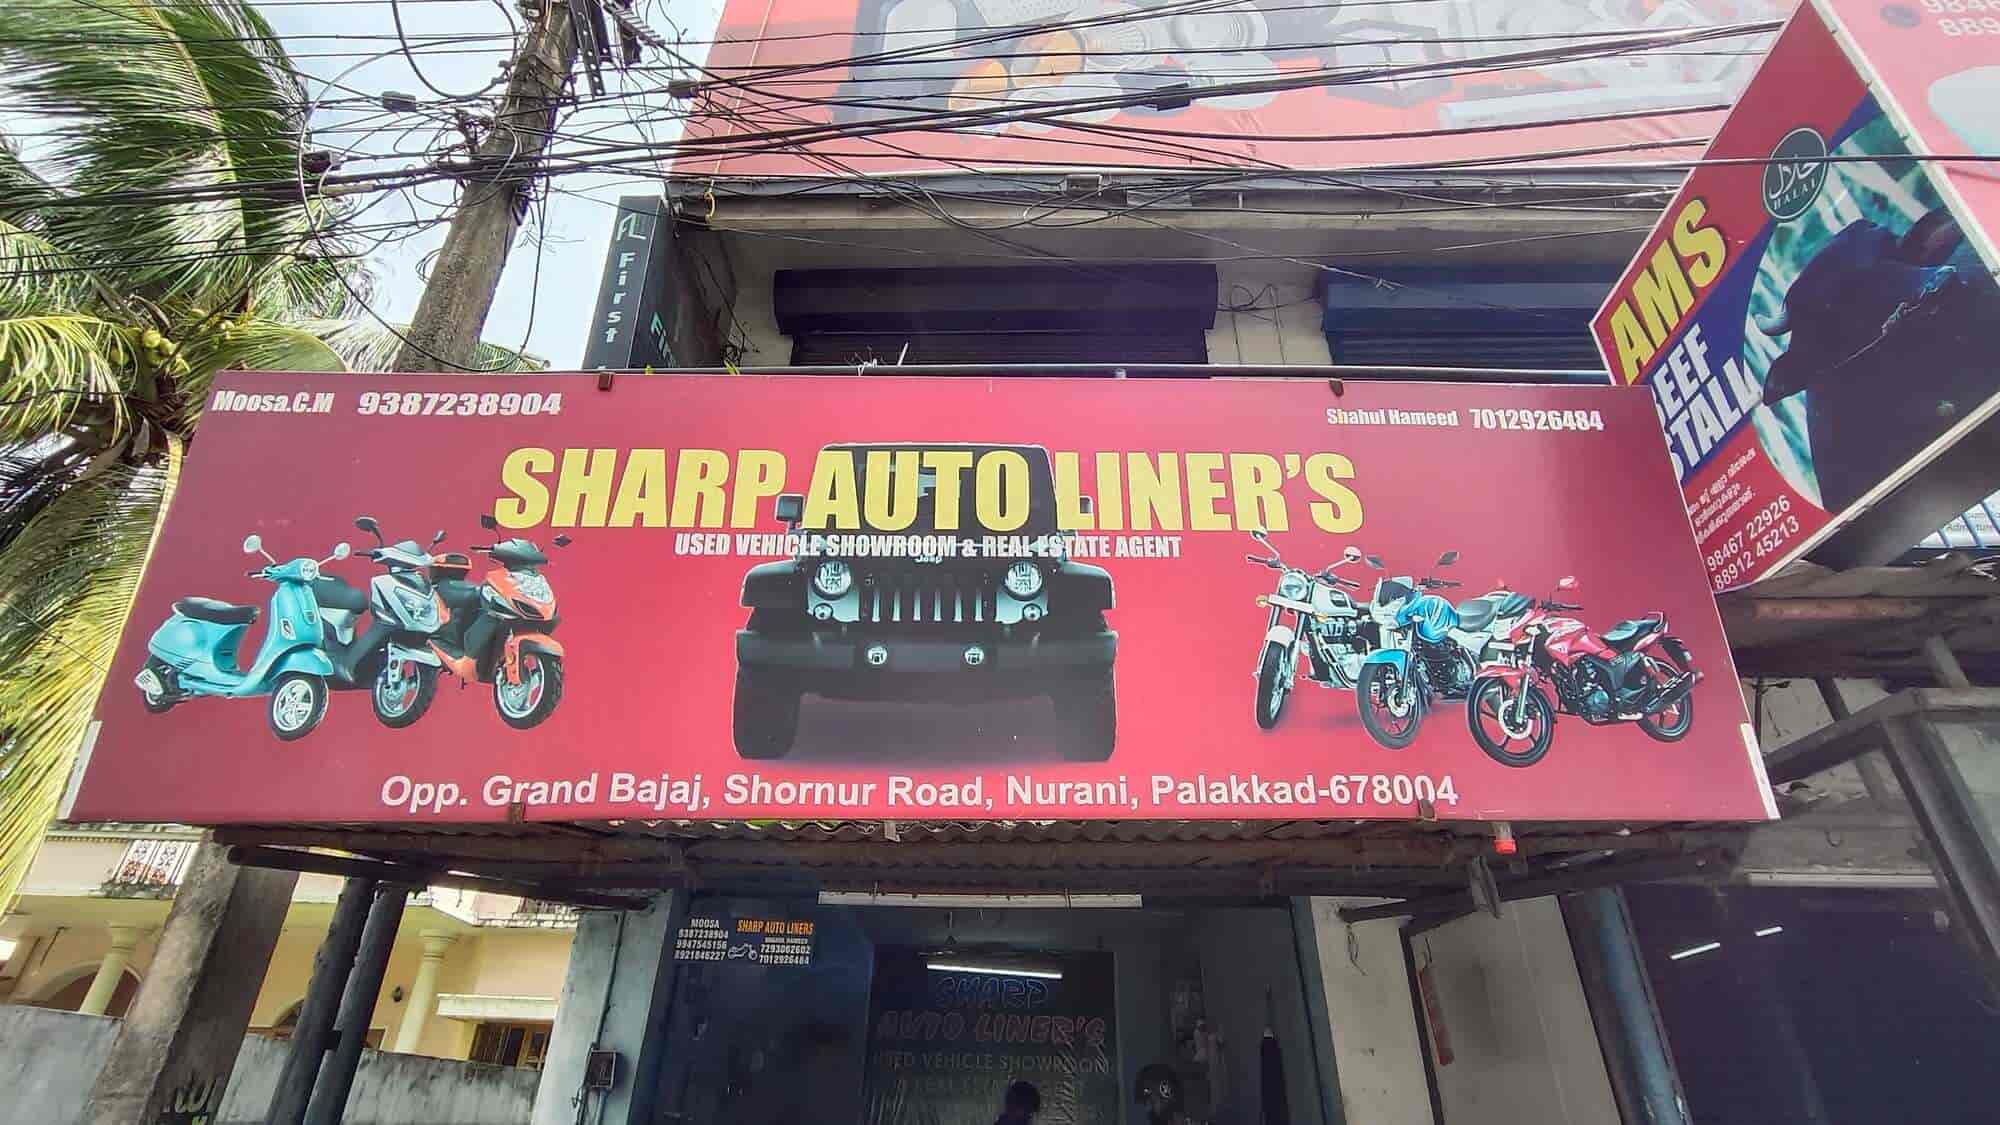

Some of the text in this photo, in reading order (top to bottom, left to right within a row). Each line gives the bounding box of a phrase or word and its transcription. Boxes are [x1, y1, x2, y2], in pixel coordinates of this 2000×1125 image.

[604, 251, 637, 343] First
[1609, 198, 1726, 384] AMS
[1652, 320, 1712, 420] EEF
[211, 390, 562, 416] Moosa.C.M 9387238904
[1326, 408, 1605, 431] Shahul Hameed 7012926484
[495, 447, 1365, 534] SHARP AUTO LINER'S
[674, 533, 1183, 558] USED VEHICLE SHOWROOM & REAL ESTATE AGENT
[1706, 530, 1744, 571] 98467
[1745, 494, 1791, 540] 22926
[1714, 551, 1755, 590] 88912
[1755, 514, 1800, 557] 45213
[381, 772, 1459, 813] Opp. Grand Bajaj, Shornur Road, Nurani, Palakkad-678004
[690, 917, 720, 929] MOOSA
[736, 919, 764, 933] SHARP
[764, 921, 786, 934] AUTO
